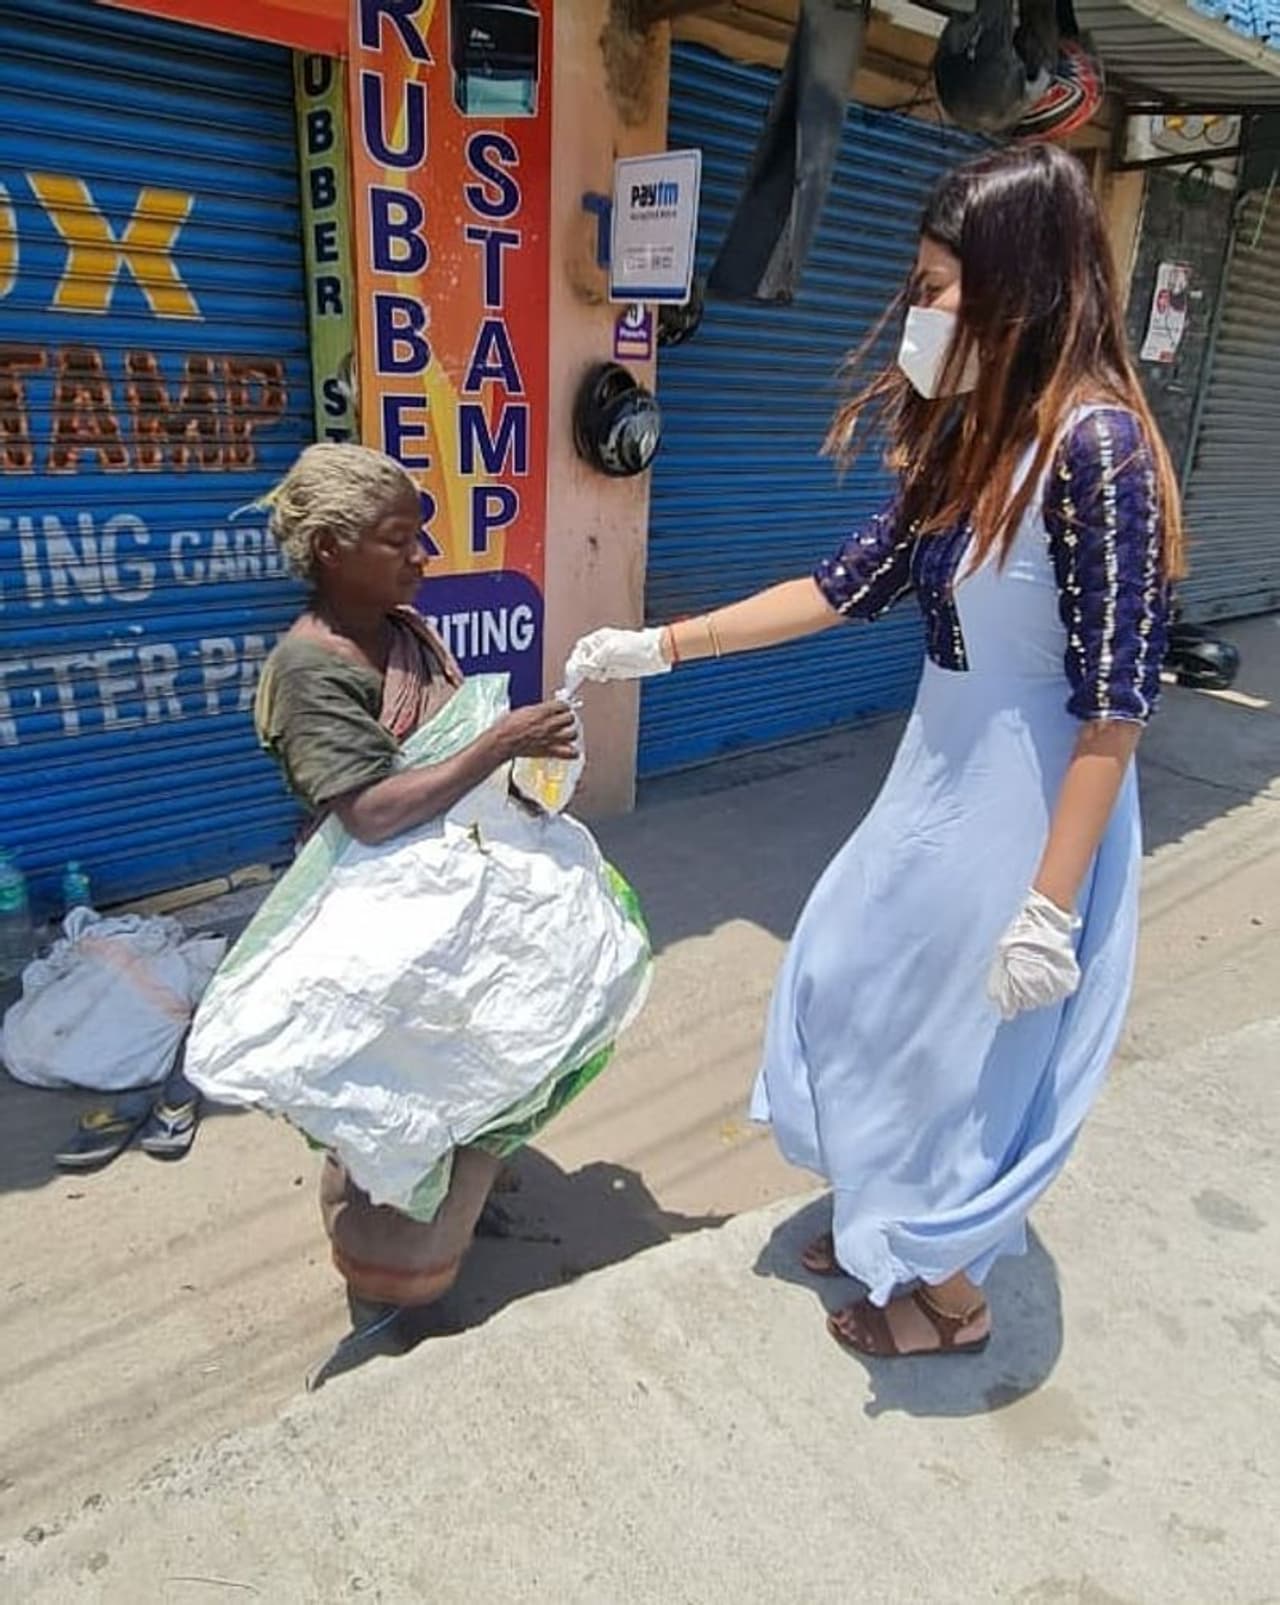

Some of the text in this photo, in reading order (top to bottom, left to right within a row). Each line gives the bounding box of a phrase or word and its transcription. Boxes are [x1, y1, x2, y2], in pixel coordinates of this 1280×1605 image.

[0, 171, 205, 321] X
[304, 55, 344, 317] UBBER
[457, 130, 530, 555] STAMP
[0, 513, 155, 608] ING
[423, 604, 535, 660] ITING
